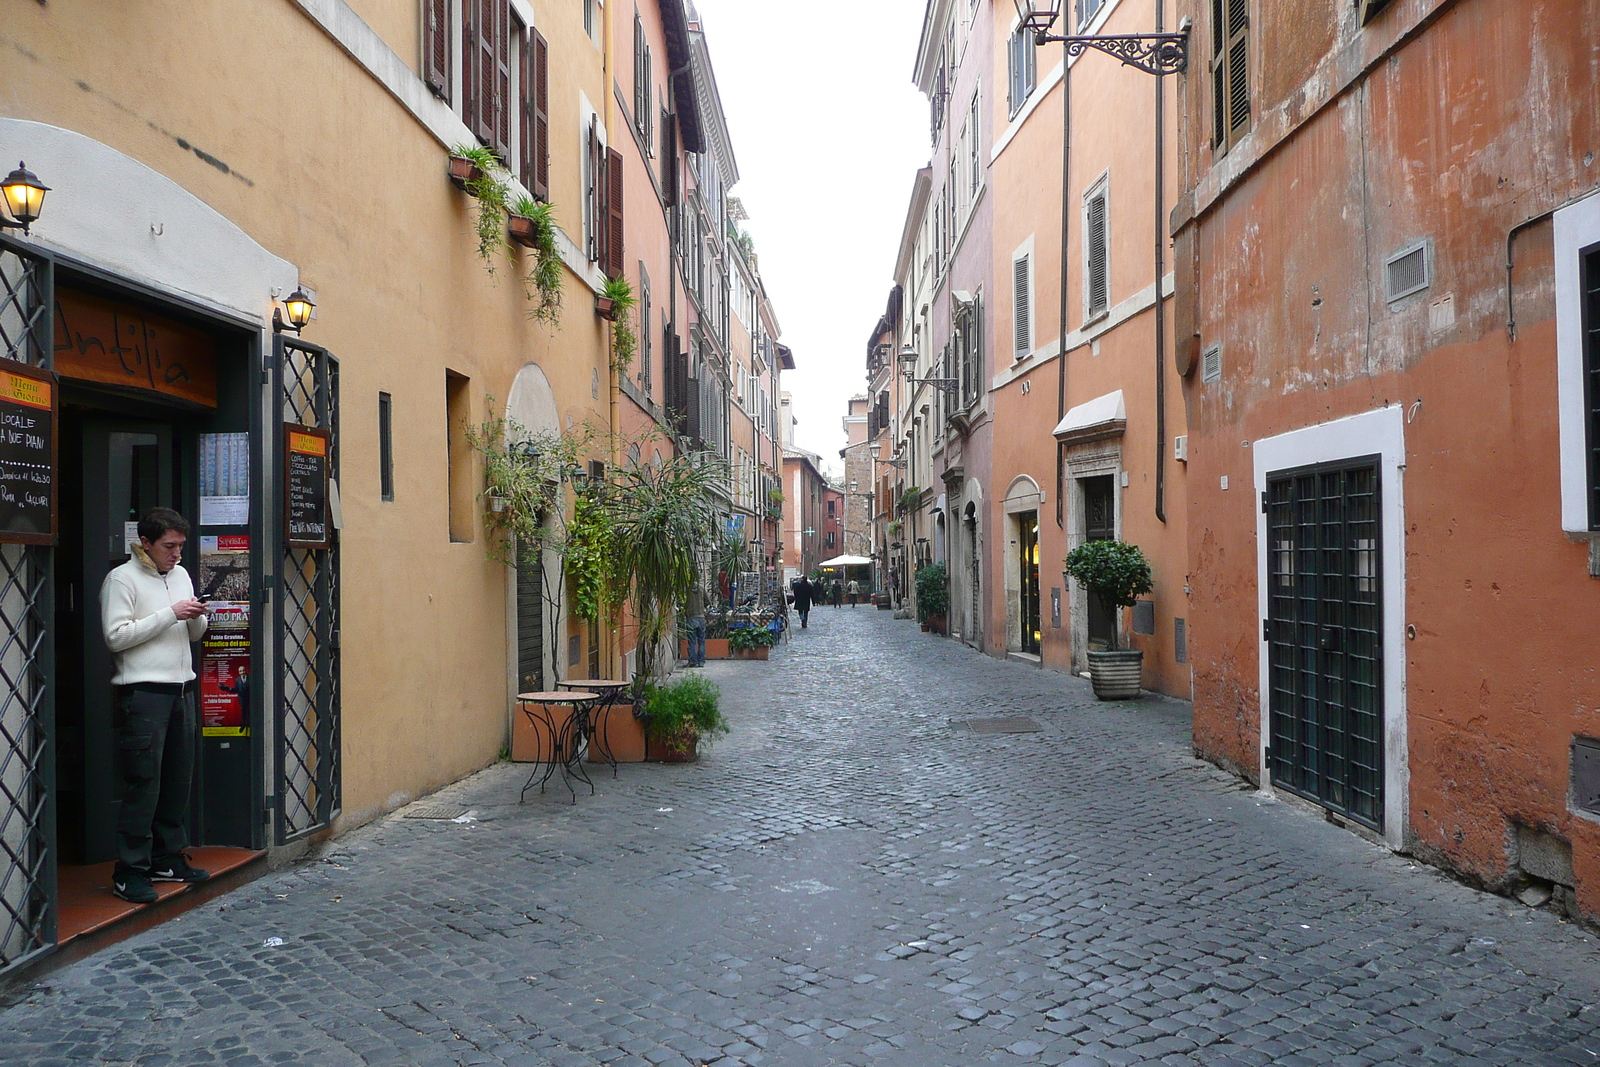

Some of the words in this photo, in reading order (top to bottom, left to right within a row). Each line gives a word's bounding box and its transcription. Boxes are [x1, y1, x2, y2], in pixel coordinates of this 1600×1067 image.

[54, 300, 191, 388] Antilia
[10, 376, 38, 392] Menu
[13, 388, 48, 405] Giorno
[1, 411, 36, 428] LOCALE
[0, 429, 6, 443] A
[9, 429, 24, 444] DUE
[26, 433, 45, 449] PIANI
[206, 613, 230, 622] EATRO
